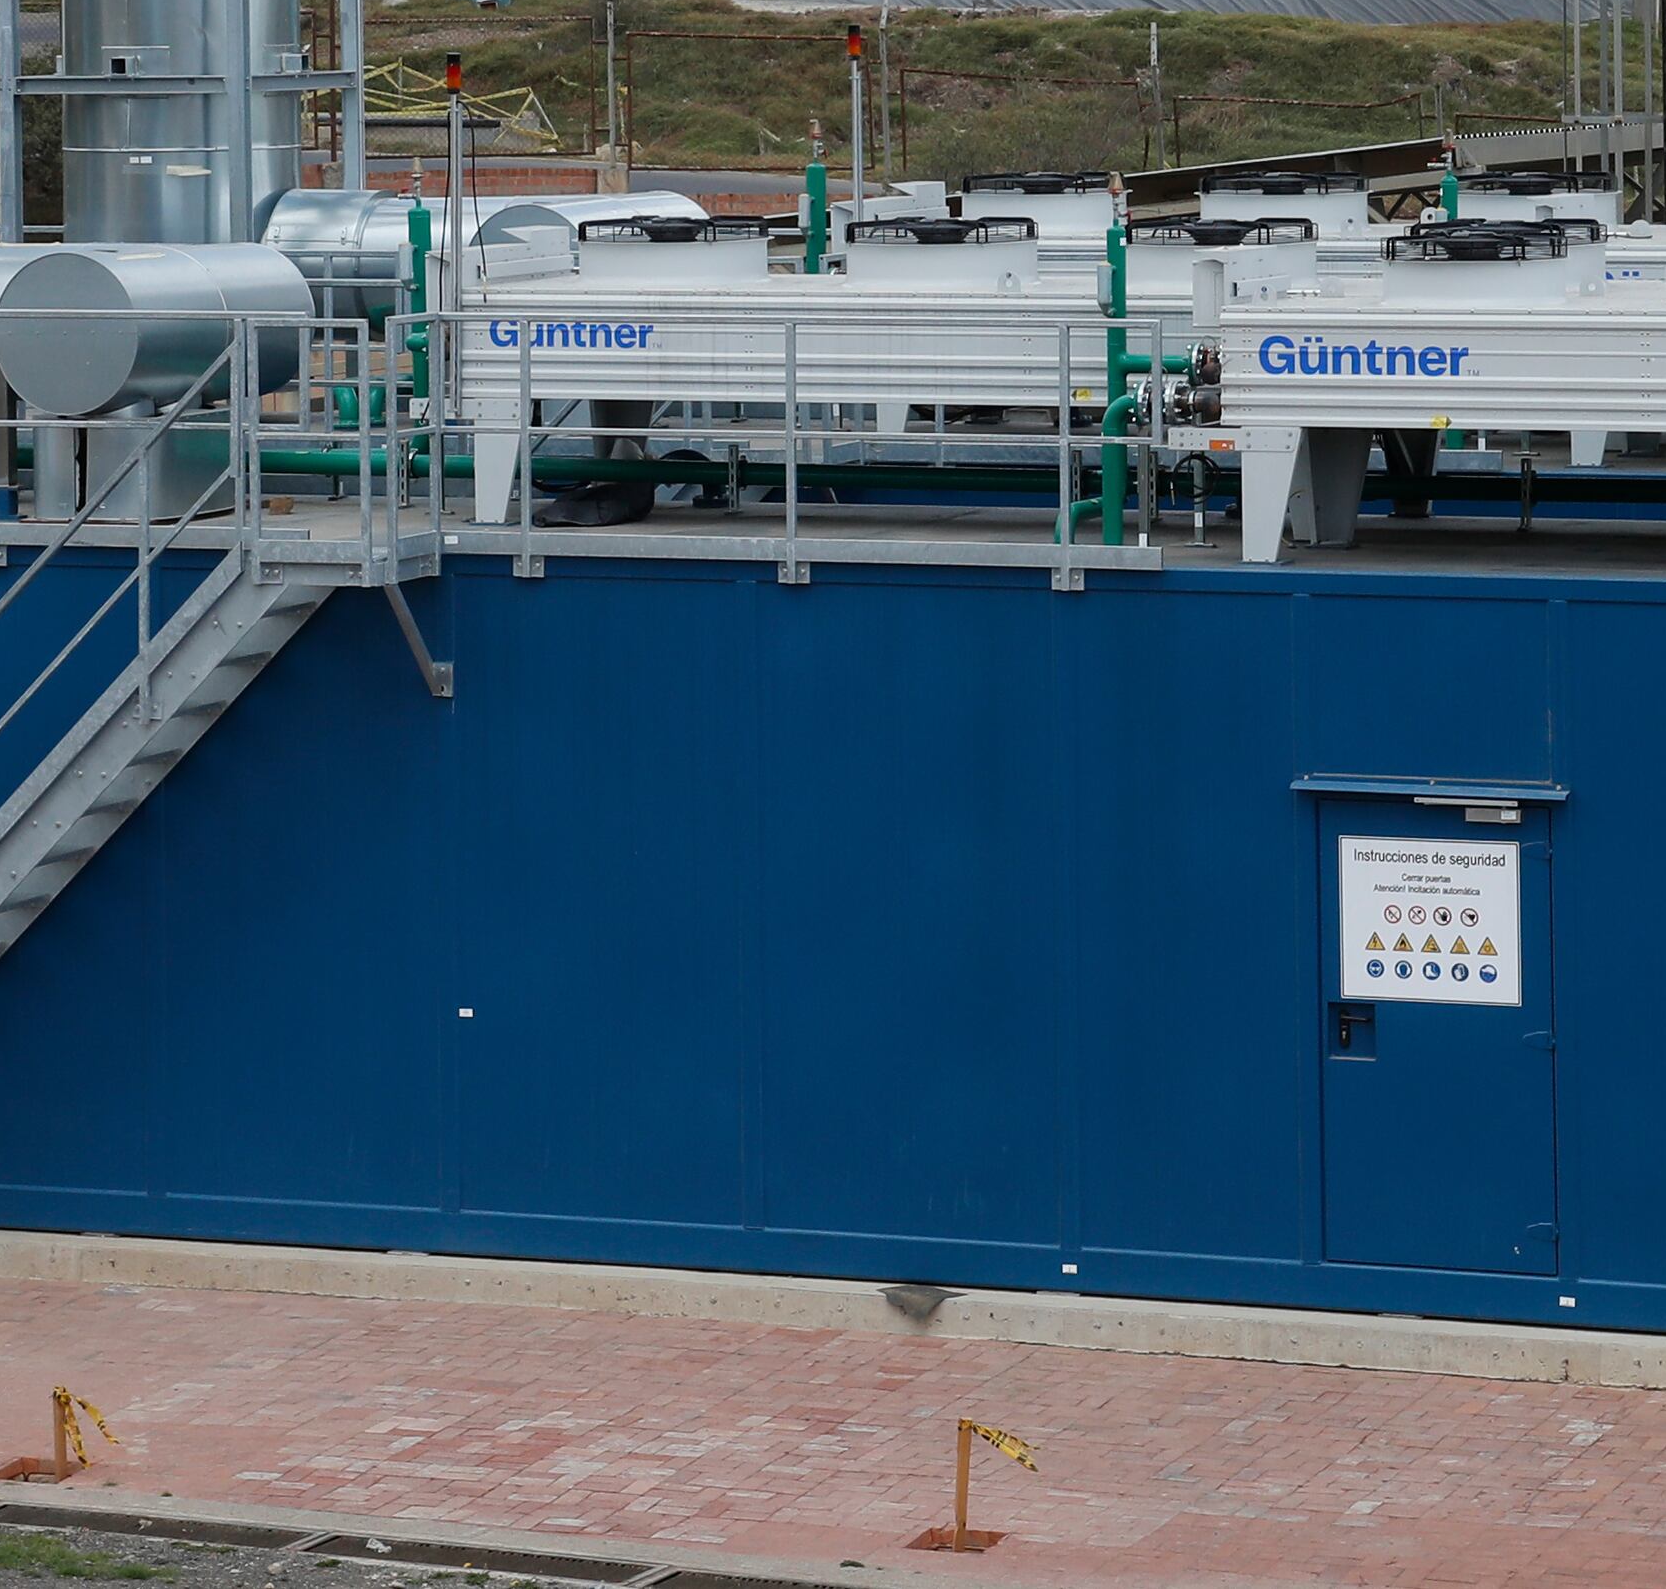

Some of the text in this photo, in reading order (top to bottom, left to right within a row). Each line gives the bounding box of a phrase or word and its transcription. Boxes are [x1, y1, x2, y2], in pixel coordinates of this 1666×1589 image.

[1258, 334, 1469, 377] Güntner
[1353, 848, 1506, 869] Instrucciones de seguridad
[1425, 875, 1452, 884] puertas
